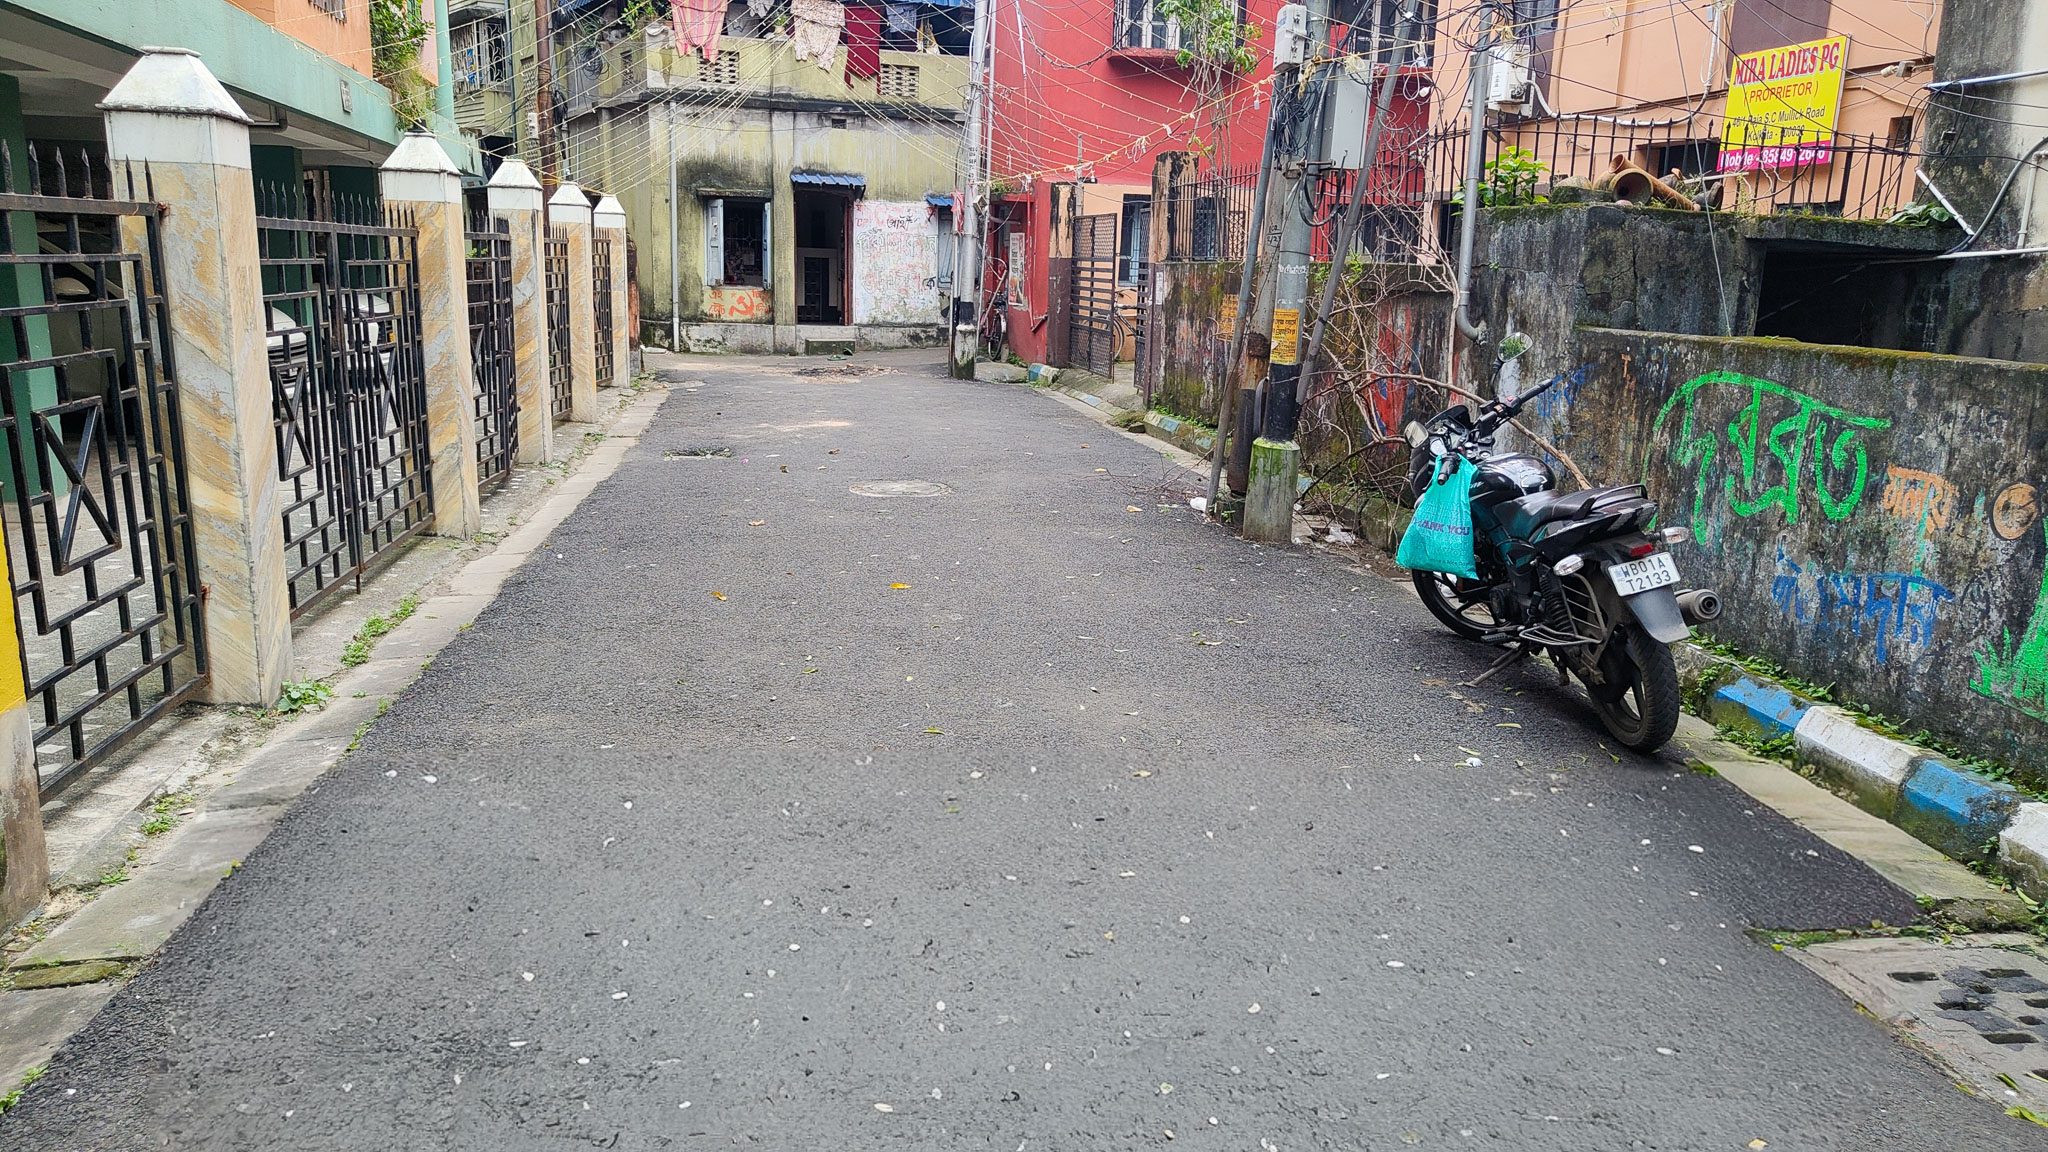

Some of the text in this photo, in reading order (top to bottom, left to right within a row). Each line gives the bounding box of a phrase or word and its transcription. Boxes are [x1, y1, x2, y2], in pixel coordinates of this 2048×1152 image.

[1733, 42, 1840, 86] MIRA LADIES PG
[1748, 113, 1763, 128] Raja
[1778, 108, 1804, 123] Mullick
[1805, 105, 1826, 120] Road
[1747, 130, 1773, 142] Kolkta
[1720, 151, 1753, 168] Moble
[1447, 524, 1470, 536] YOU
[1620, 557, 1666, 578] WB01A
[1626, 569, 1671, 592] T2133
